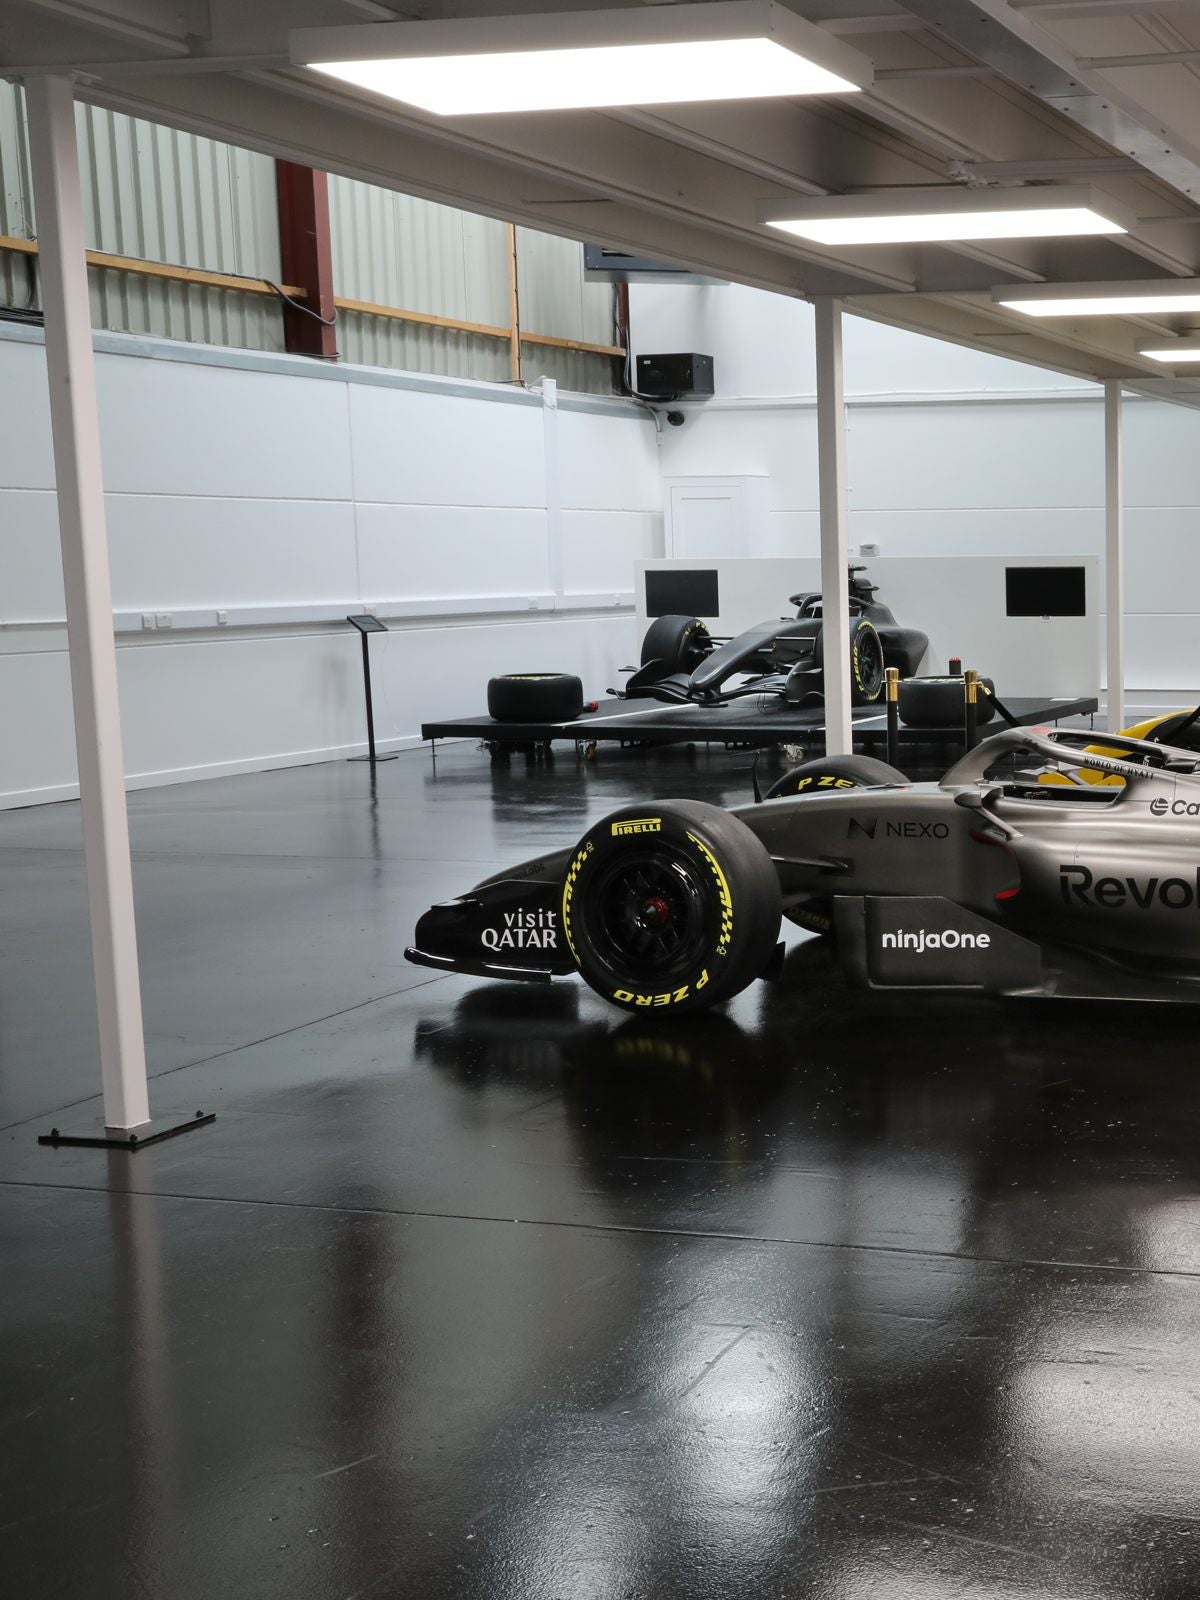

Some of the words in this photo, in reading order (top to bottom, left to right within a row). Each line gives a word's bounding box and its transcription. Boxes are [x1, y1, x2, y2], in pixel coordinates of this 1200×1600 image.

[1084, 756, 1112, 771] WORLD
[1114, 764, 1125, 773] OF
[1127, 767, 1154, 781] HYATT
[798, 777, 812, 791] P
[611, 818, 662, 836] PIRELLI
[886, 821, 950, 839] NEXO
[503, 907, 557, 928] visit
[481, 928, 558, 952] QATAR
[882, 929, 991, 953] ninjaOne
[696, 968, 709, 990] P
[613, 985, 690, 1007] ZERO
